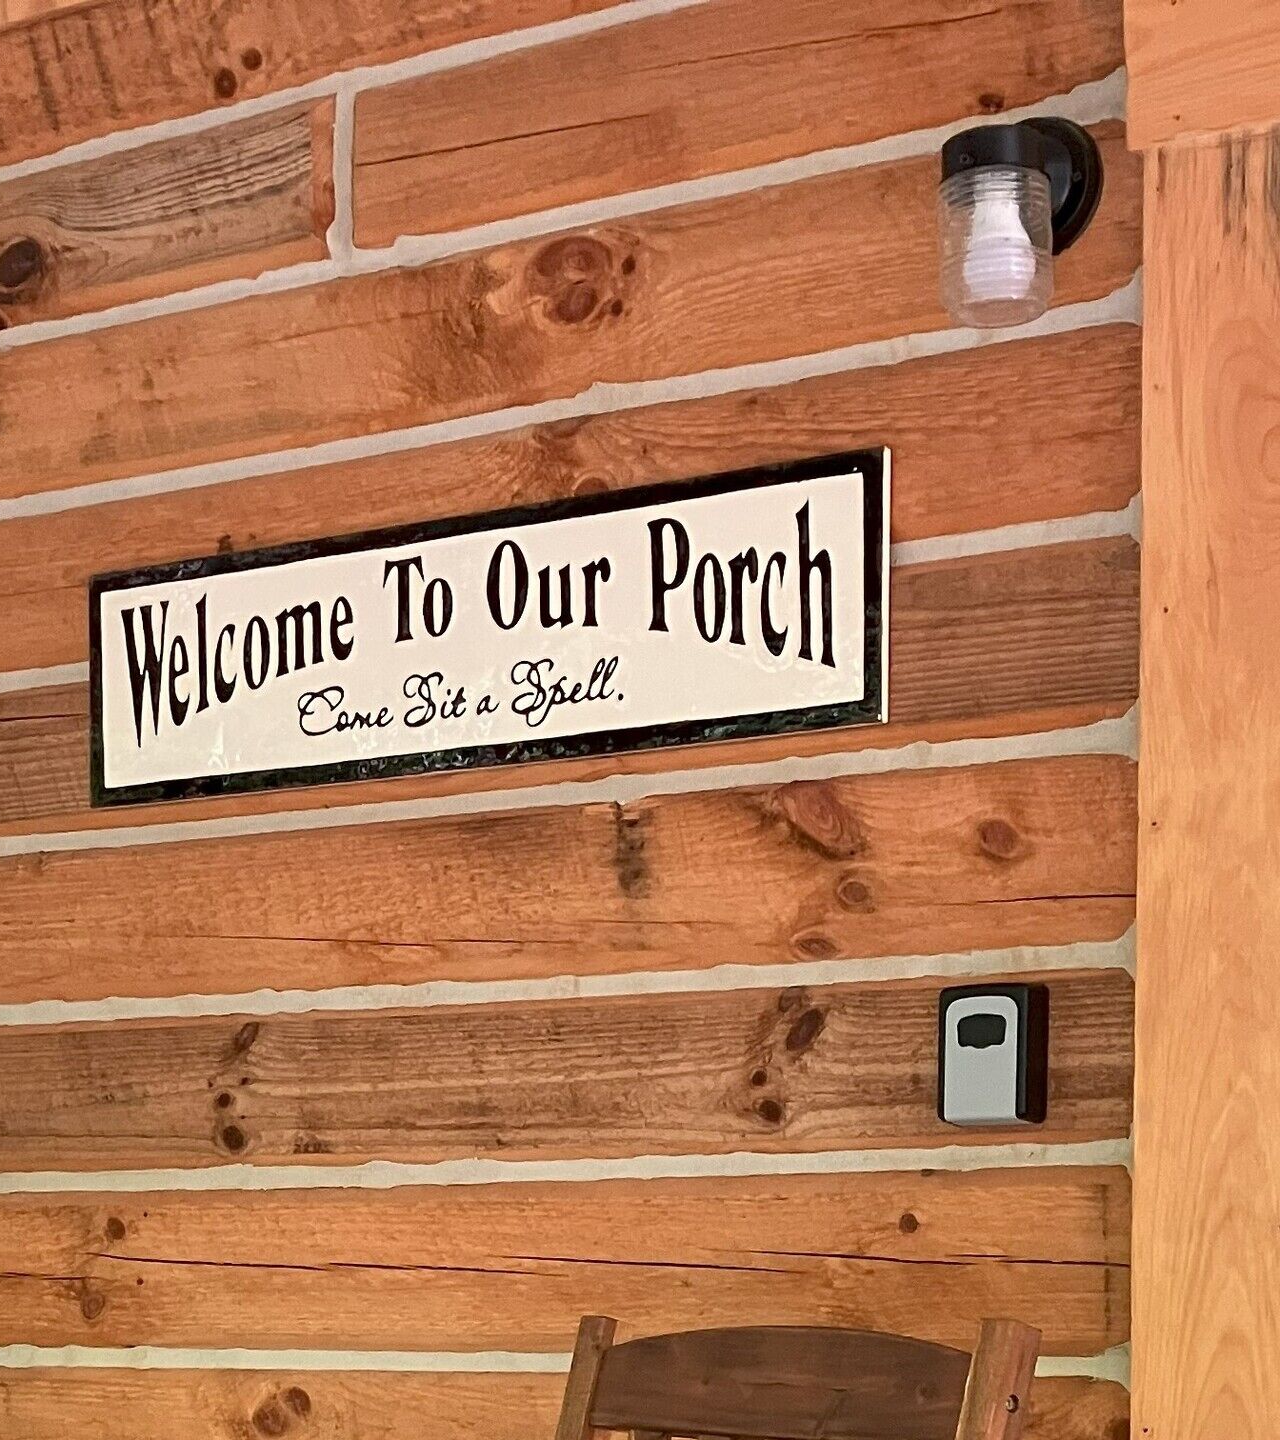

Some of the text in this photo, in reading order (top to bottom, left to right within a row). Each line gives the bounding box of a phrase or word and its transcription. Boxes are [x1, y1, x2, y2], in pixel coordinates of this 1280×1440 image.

[120, 499, 837, 748] Welcome To Our Porch
[297, 655, 626, 737] Come Sit a Spell.
